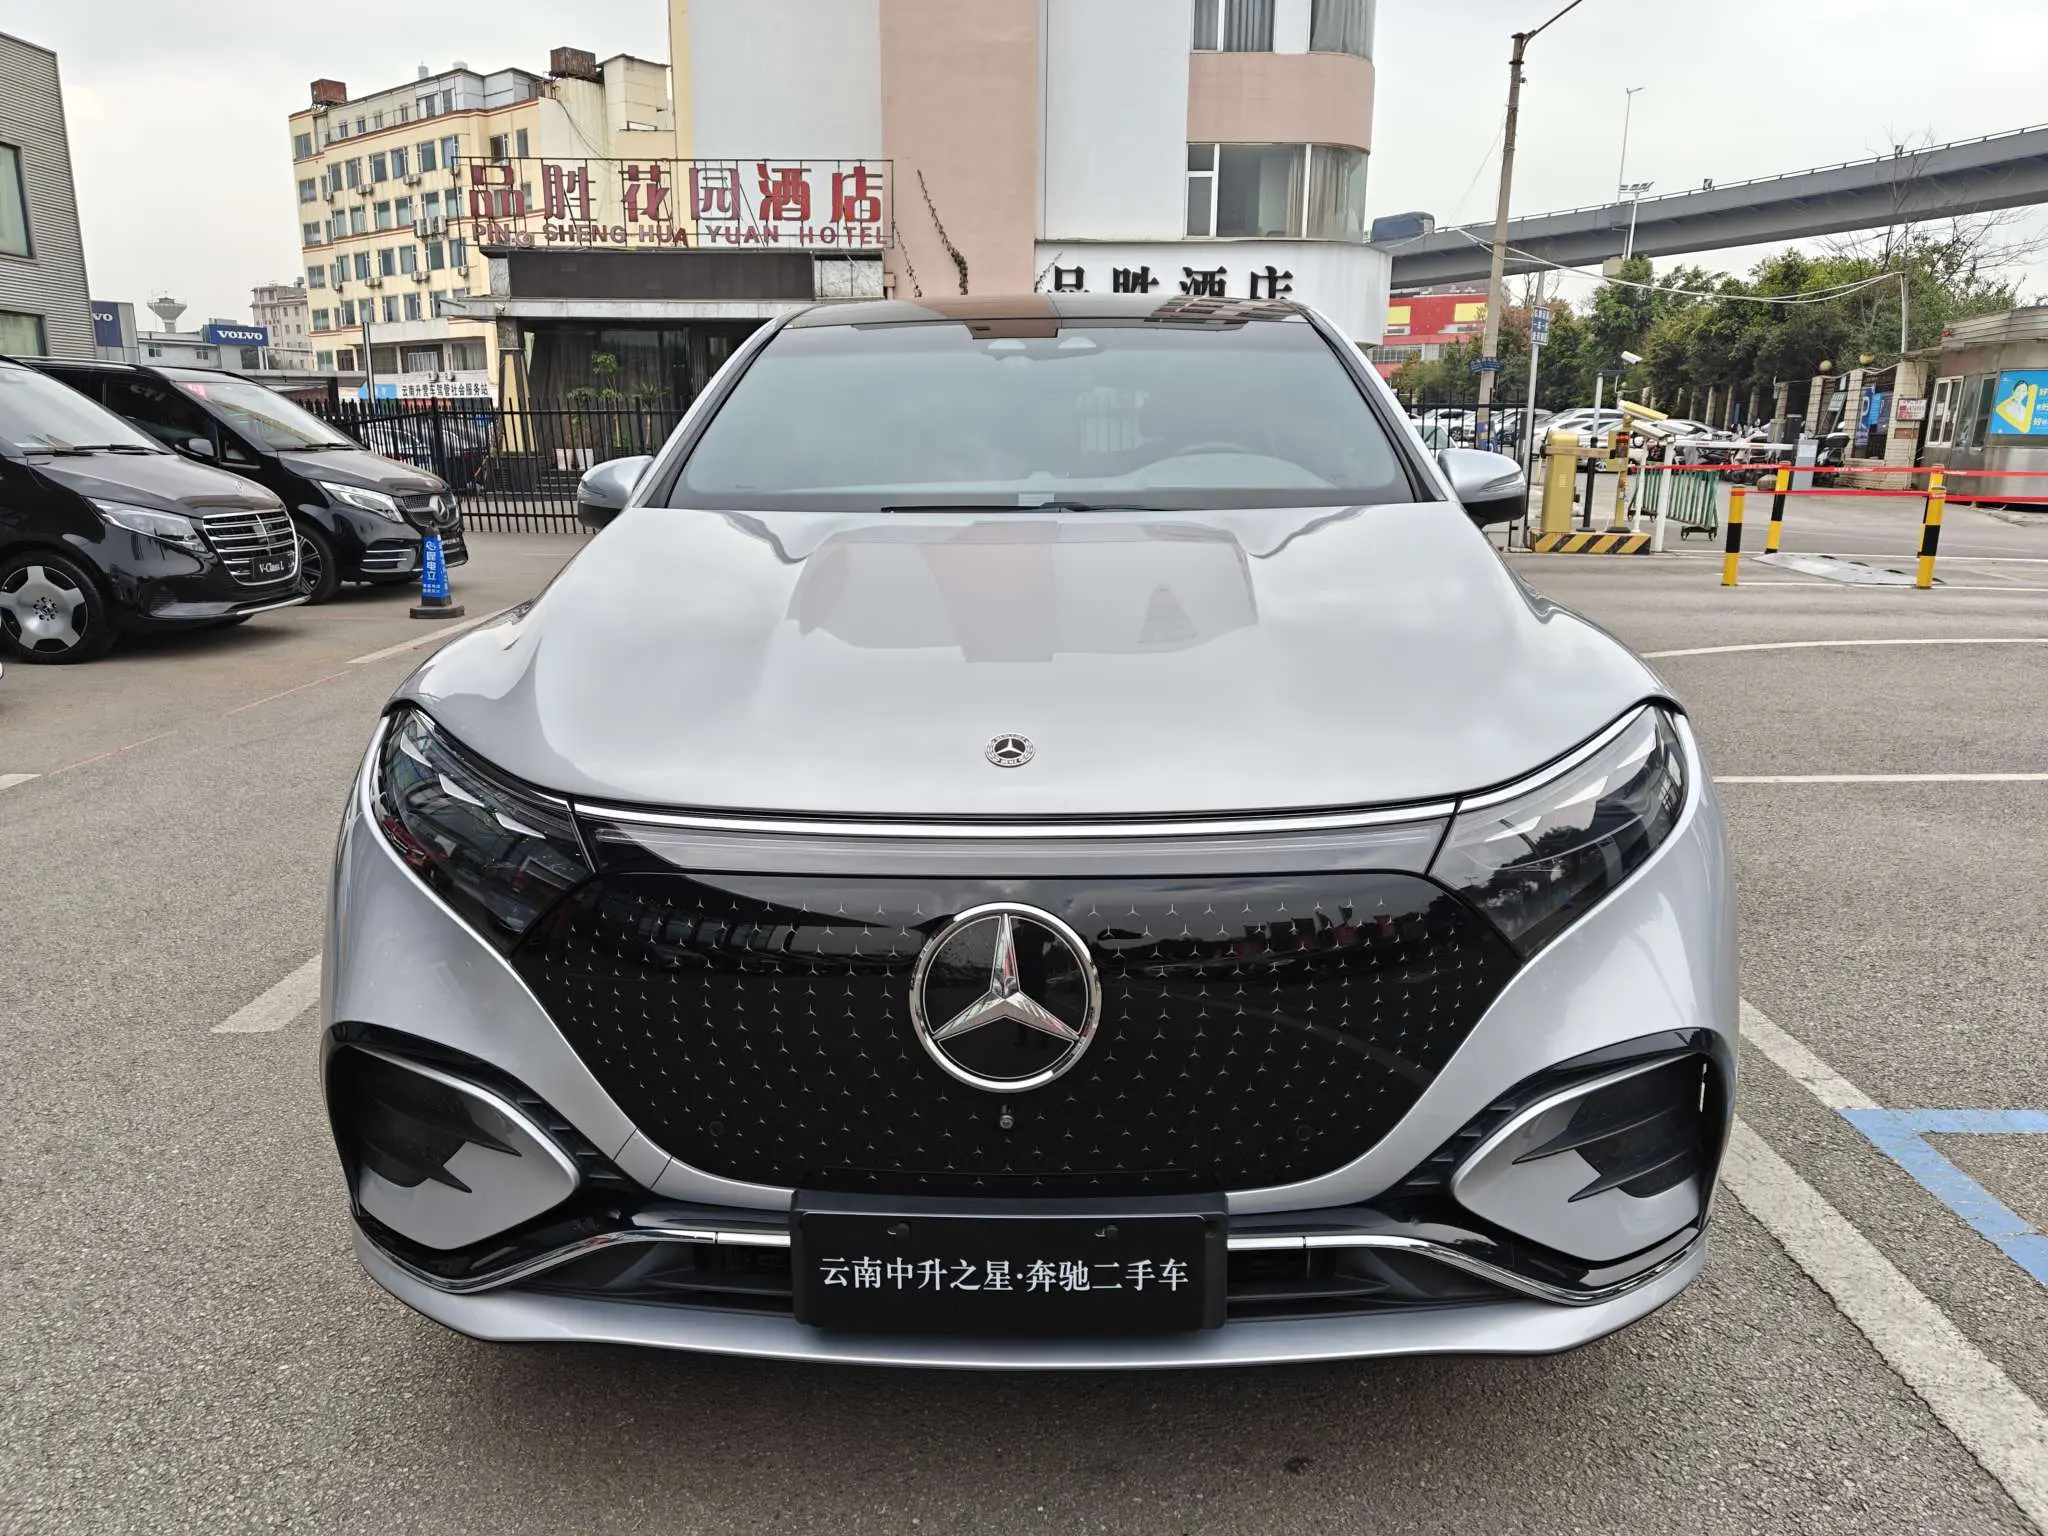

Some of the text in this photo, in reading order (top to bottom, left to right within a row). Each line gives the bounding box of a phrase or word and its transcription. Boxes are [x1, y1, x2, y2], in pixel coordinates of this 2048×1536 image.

[470, 163, 884, 224] 品胜花园酒店
[542, 222, 627, 244] SHENG
[638, 224, 689, 247] HUA
[705, 225, 779, 244] YUAN
[800, 226, 887, 245] HOTEL
[217, 330, 263, 340] VOLVO
[819, 1256, 1189, 1293] 云南中升之星·奔驰二手车
